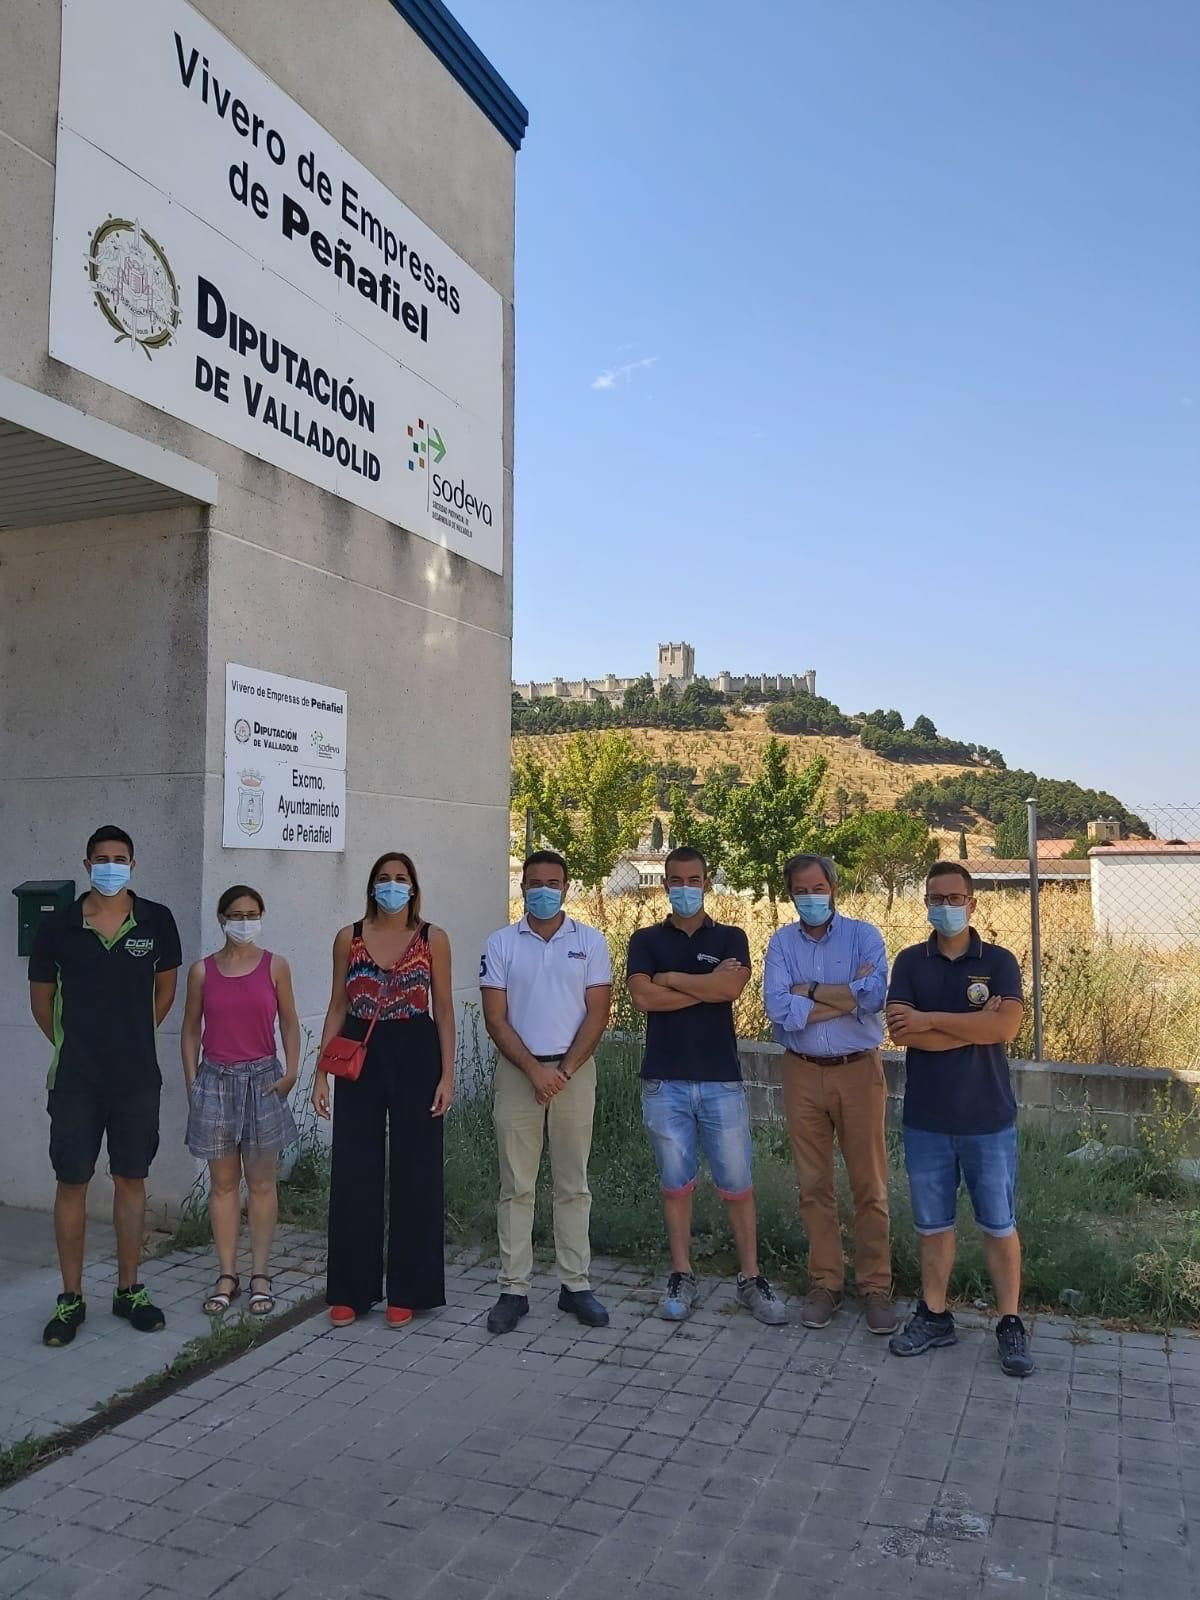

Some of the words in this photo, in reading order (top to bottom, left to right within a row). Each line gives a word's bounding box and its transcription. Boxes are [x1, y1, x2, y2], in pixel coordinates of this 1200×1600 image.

[173, 31, 286, 166] Vivero
[298, 151, 333, 206] de
[341, 181, 462, 314] Empresas
[229, 161, 269, 219] de
[283, 195, 429, 342] Peñafiel
[194, 355, 230, 404] DE
[432, 473, 493, 527] sodeva
[231, 679, 255, 696] Vivero
[256, 685, 266, 698] de
[267, 688, 300, 706] Empresas
[311, 698, 344, 715] Peñafiel
[292, 768, 326, 791] Excmo.
[277, 794, 340, 818] Ayuntamiento
[282, 824, 295, 842] de
[297, 825, 332, 844] Peñafiel
[125, 938, 154, 949] DGH
